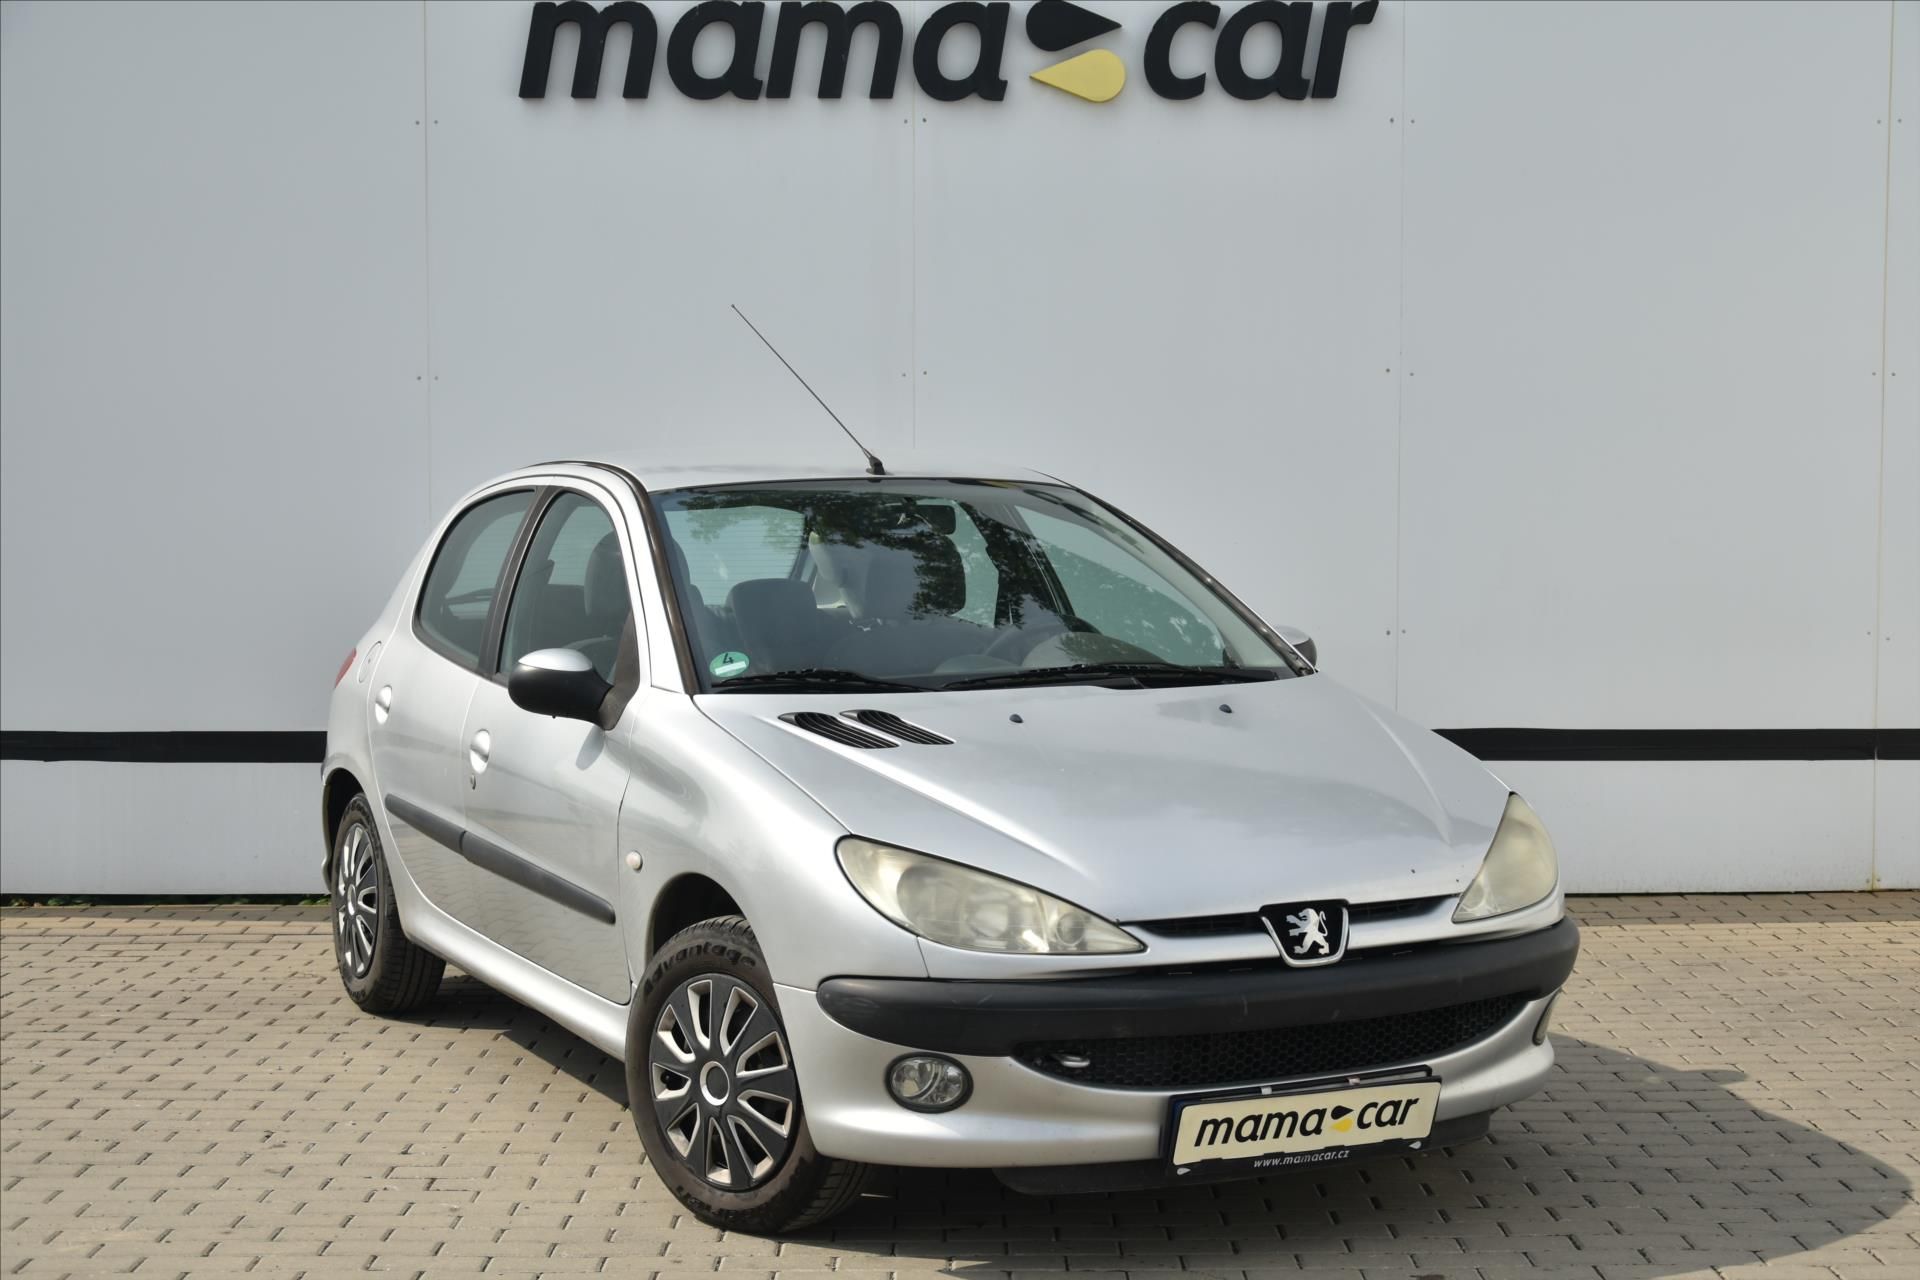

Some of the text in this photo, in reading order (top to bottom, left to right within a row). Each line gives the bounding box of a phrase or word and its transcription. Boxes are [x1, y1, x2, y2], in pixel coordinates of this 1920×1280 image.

[1194, 1097, 1419, 1147] mama car
[1253, 1149, 1350, 1168] www.mamacar.cz
